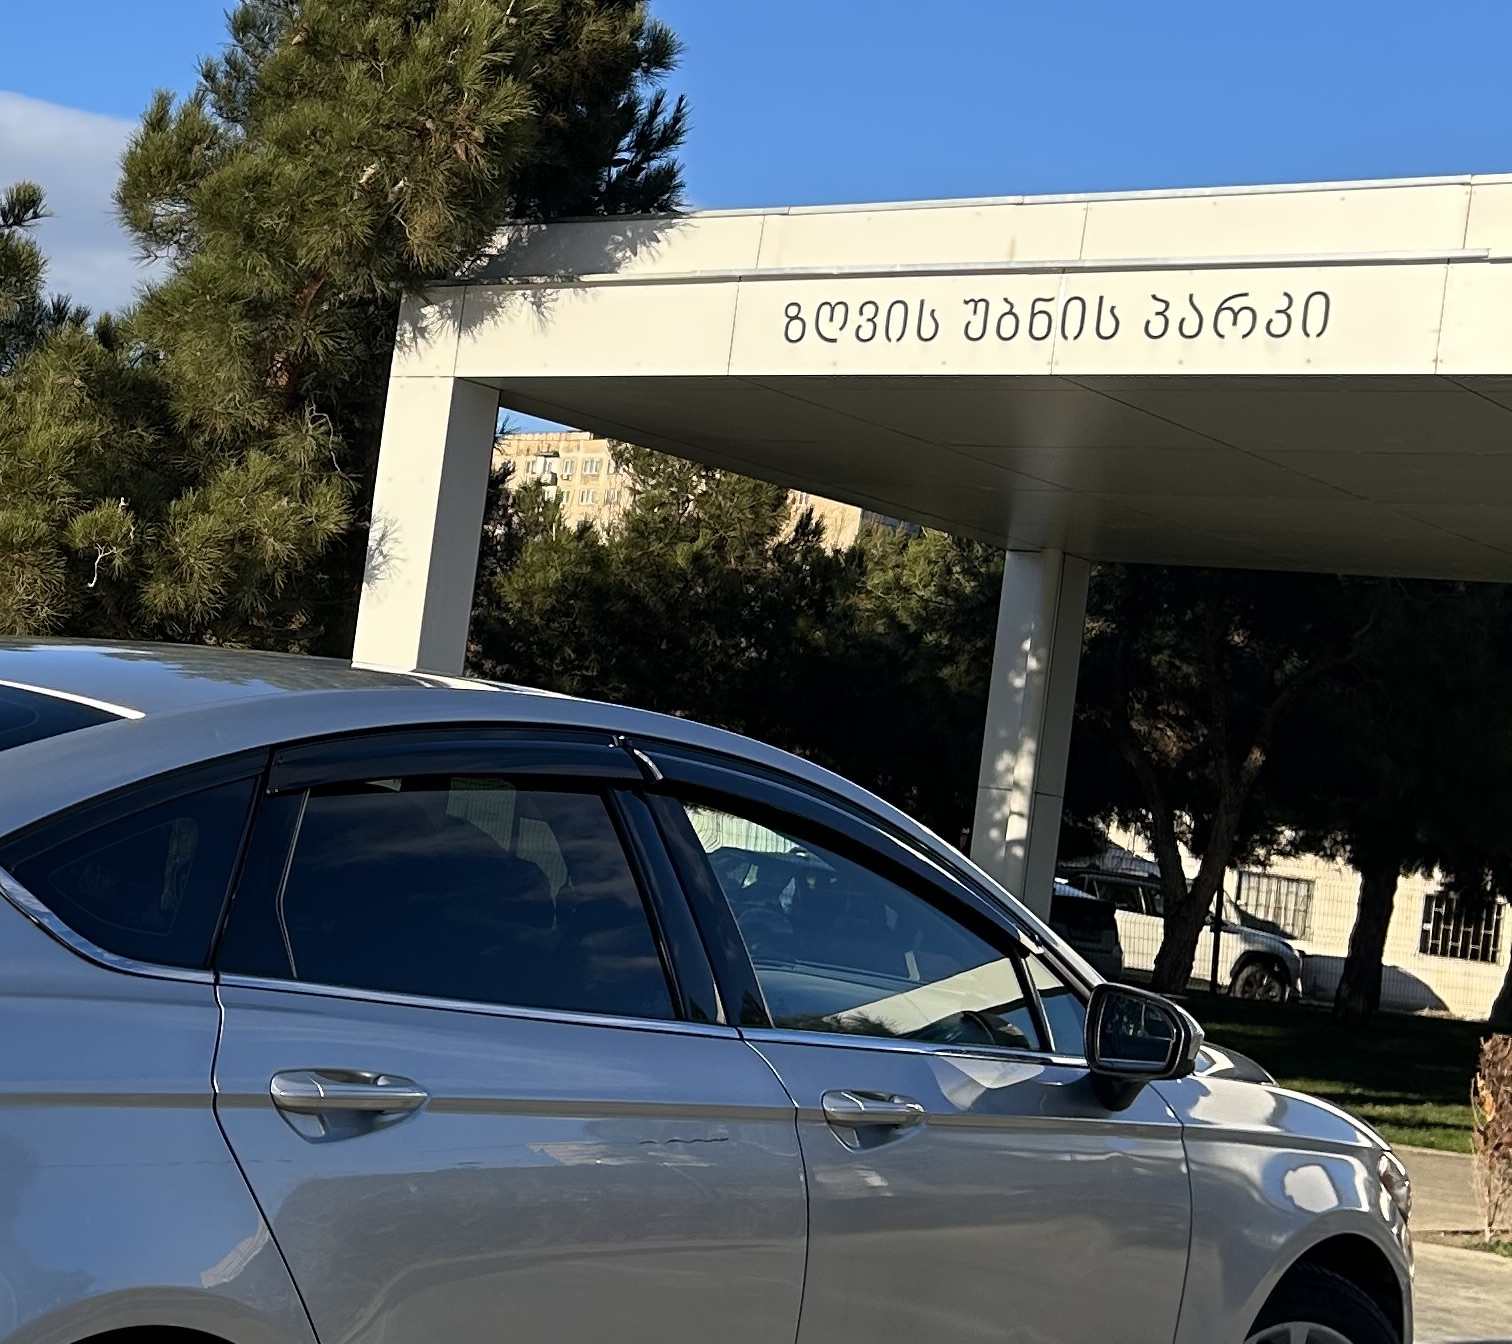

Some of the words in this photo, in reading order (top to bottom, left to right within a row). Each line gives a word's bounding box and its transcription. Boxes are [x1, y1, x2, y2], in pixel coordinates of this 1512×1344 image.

[783, 298, 940, 344] ზღვის
[962, 294, 1121, 342] უბნის
[1143, 290, 1331, 340] პარკი
